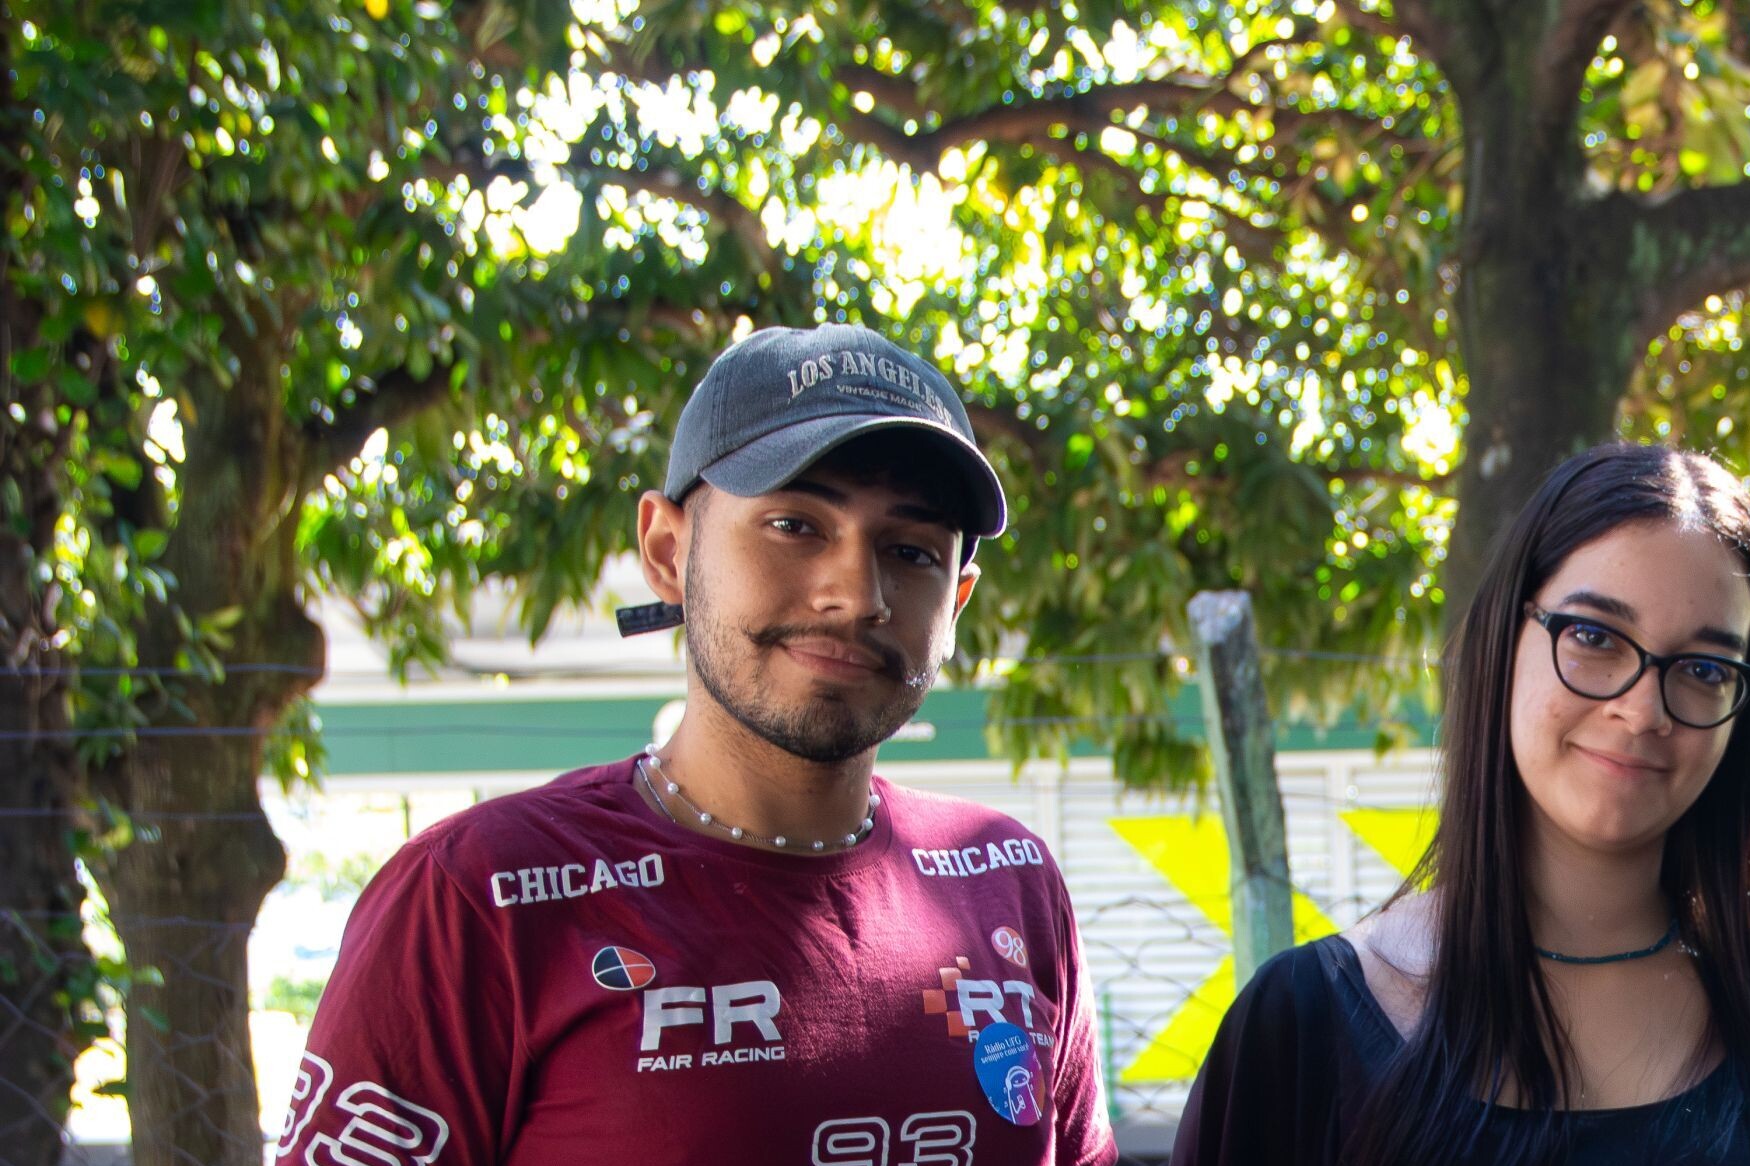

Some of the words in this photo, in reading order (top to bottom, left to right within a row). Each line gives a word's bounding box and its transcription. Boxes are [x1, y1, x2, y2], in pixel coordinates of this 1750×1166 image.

[787, 354, 833, 399] LOS
[840, 350, 952, 428] ANGELES
[836, 384, 889, 400] VINTAGE
[491, 853, 665, 907] CHICAGO
[911, 839, 1043, 877] CHICAGO
[995, 930, 1027, 967] 98
[640, 980, 782, 1051] FR
[956, 979, 1034, 1029] RT
[637, 1054, 692, 1072] FAIR
[702, 1046, 785, 1066] RACING
